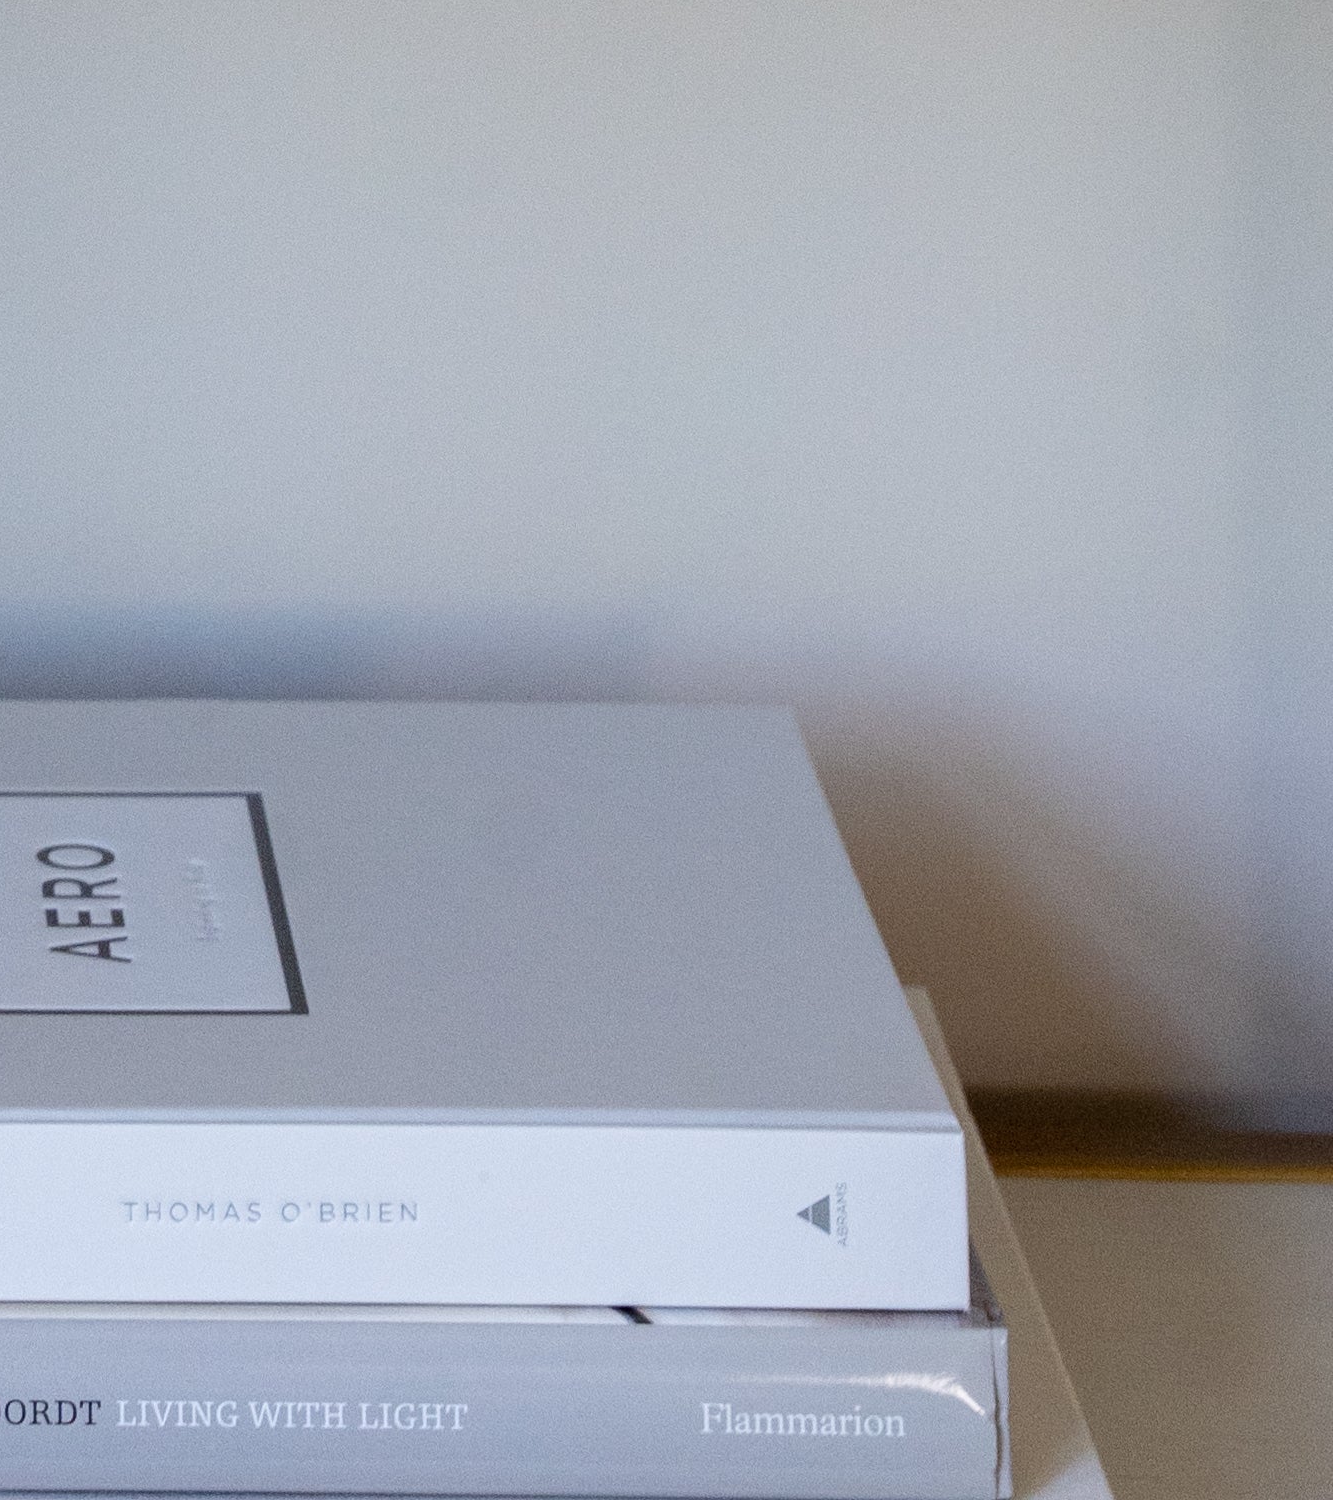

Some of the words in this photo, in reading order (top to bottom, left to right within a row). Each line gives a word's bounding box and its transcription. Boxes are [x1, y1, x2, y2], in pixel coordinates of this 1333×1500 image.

[36, 843, 132, 963] AERO
[123, 1201, 264, 1224] THOMAS
[280, 1201, 420, 1224] O'BRIEN
[834, 1181, 849, 1247] ABRAMS
[115, 1399, 240, 1429] LIVING
[248, 1399, 346, 1430] WITH
[357, 1400, 470, 1431] LIGHT
[699, 1400, 907, 1439] Flammarion
